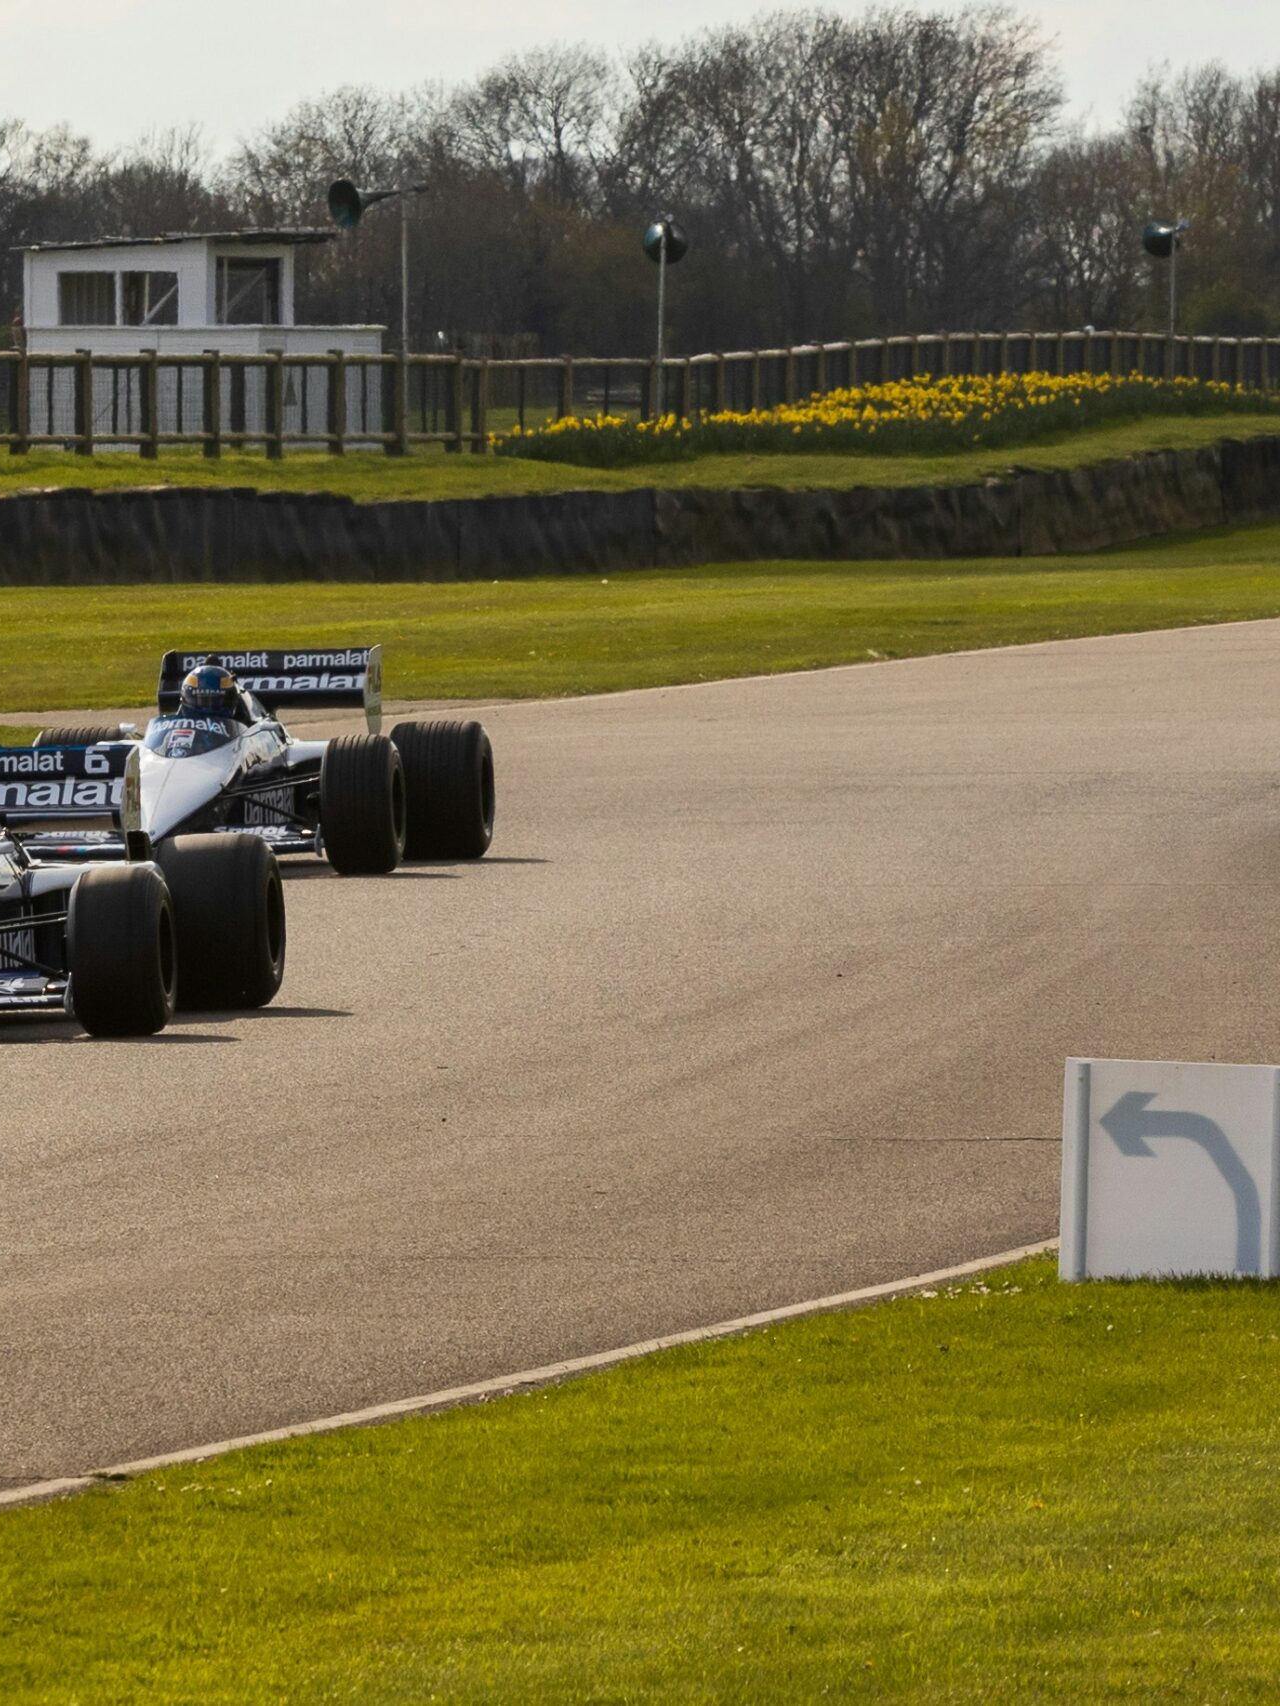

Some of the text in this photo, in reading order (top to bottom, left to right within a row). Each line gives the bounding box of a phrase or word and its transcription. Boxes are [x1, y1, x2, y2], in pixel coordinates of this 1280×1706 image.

[183, 649, 370, 671] pamalat parmalat
[237, 672, 367, 690] rmalat
[84, 746, 110, 774] 6
